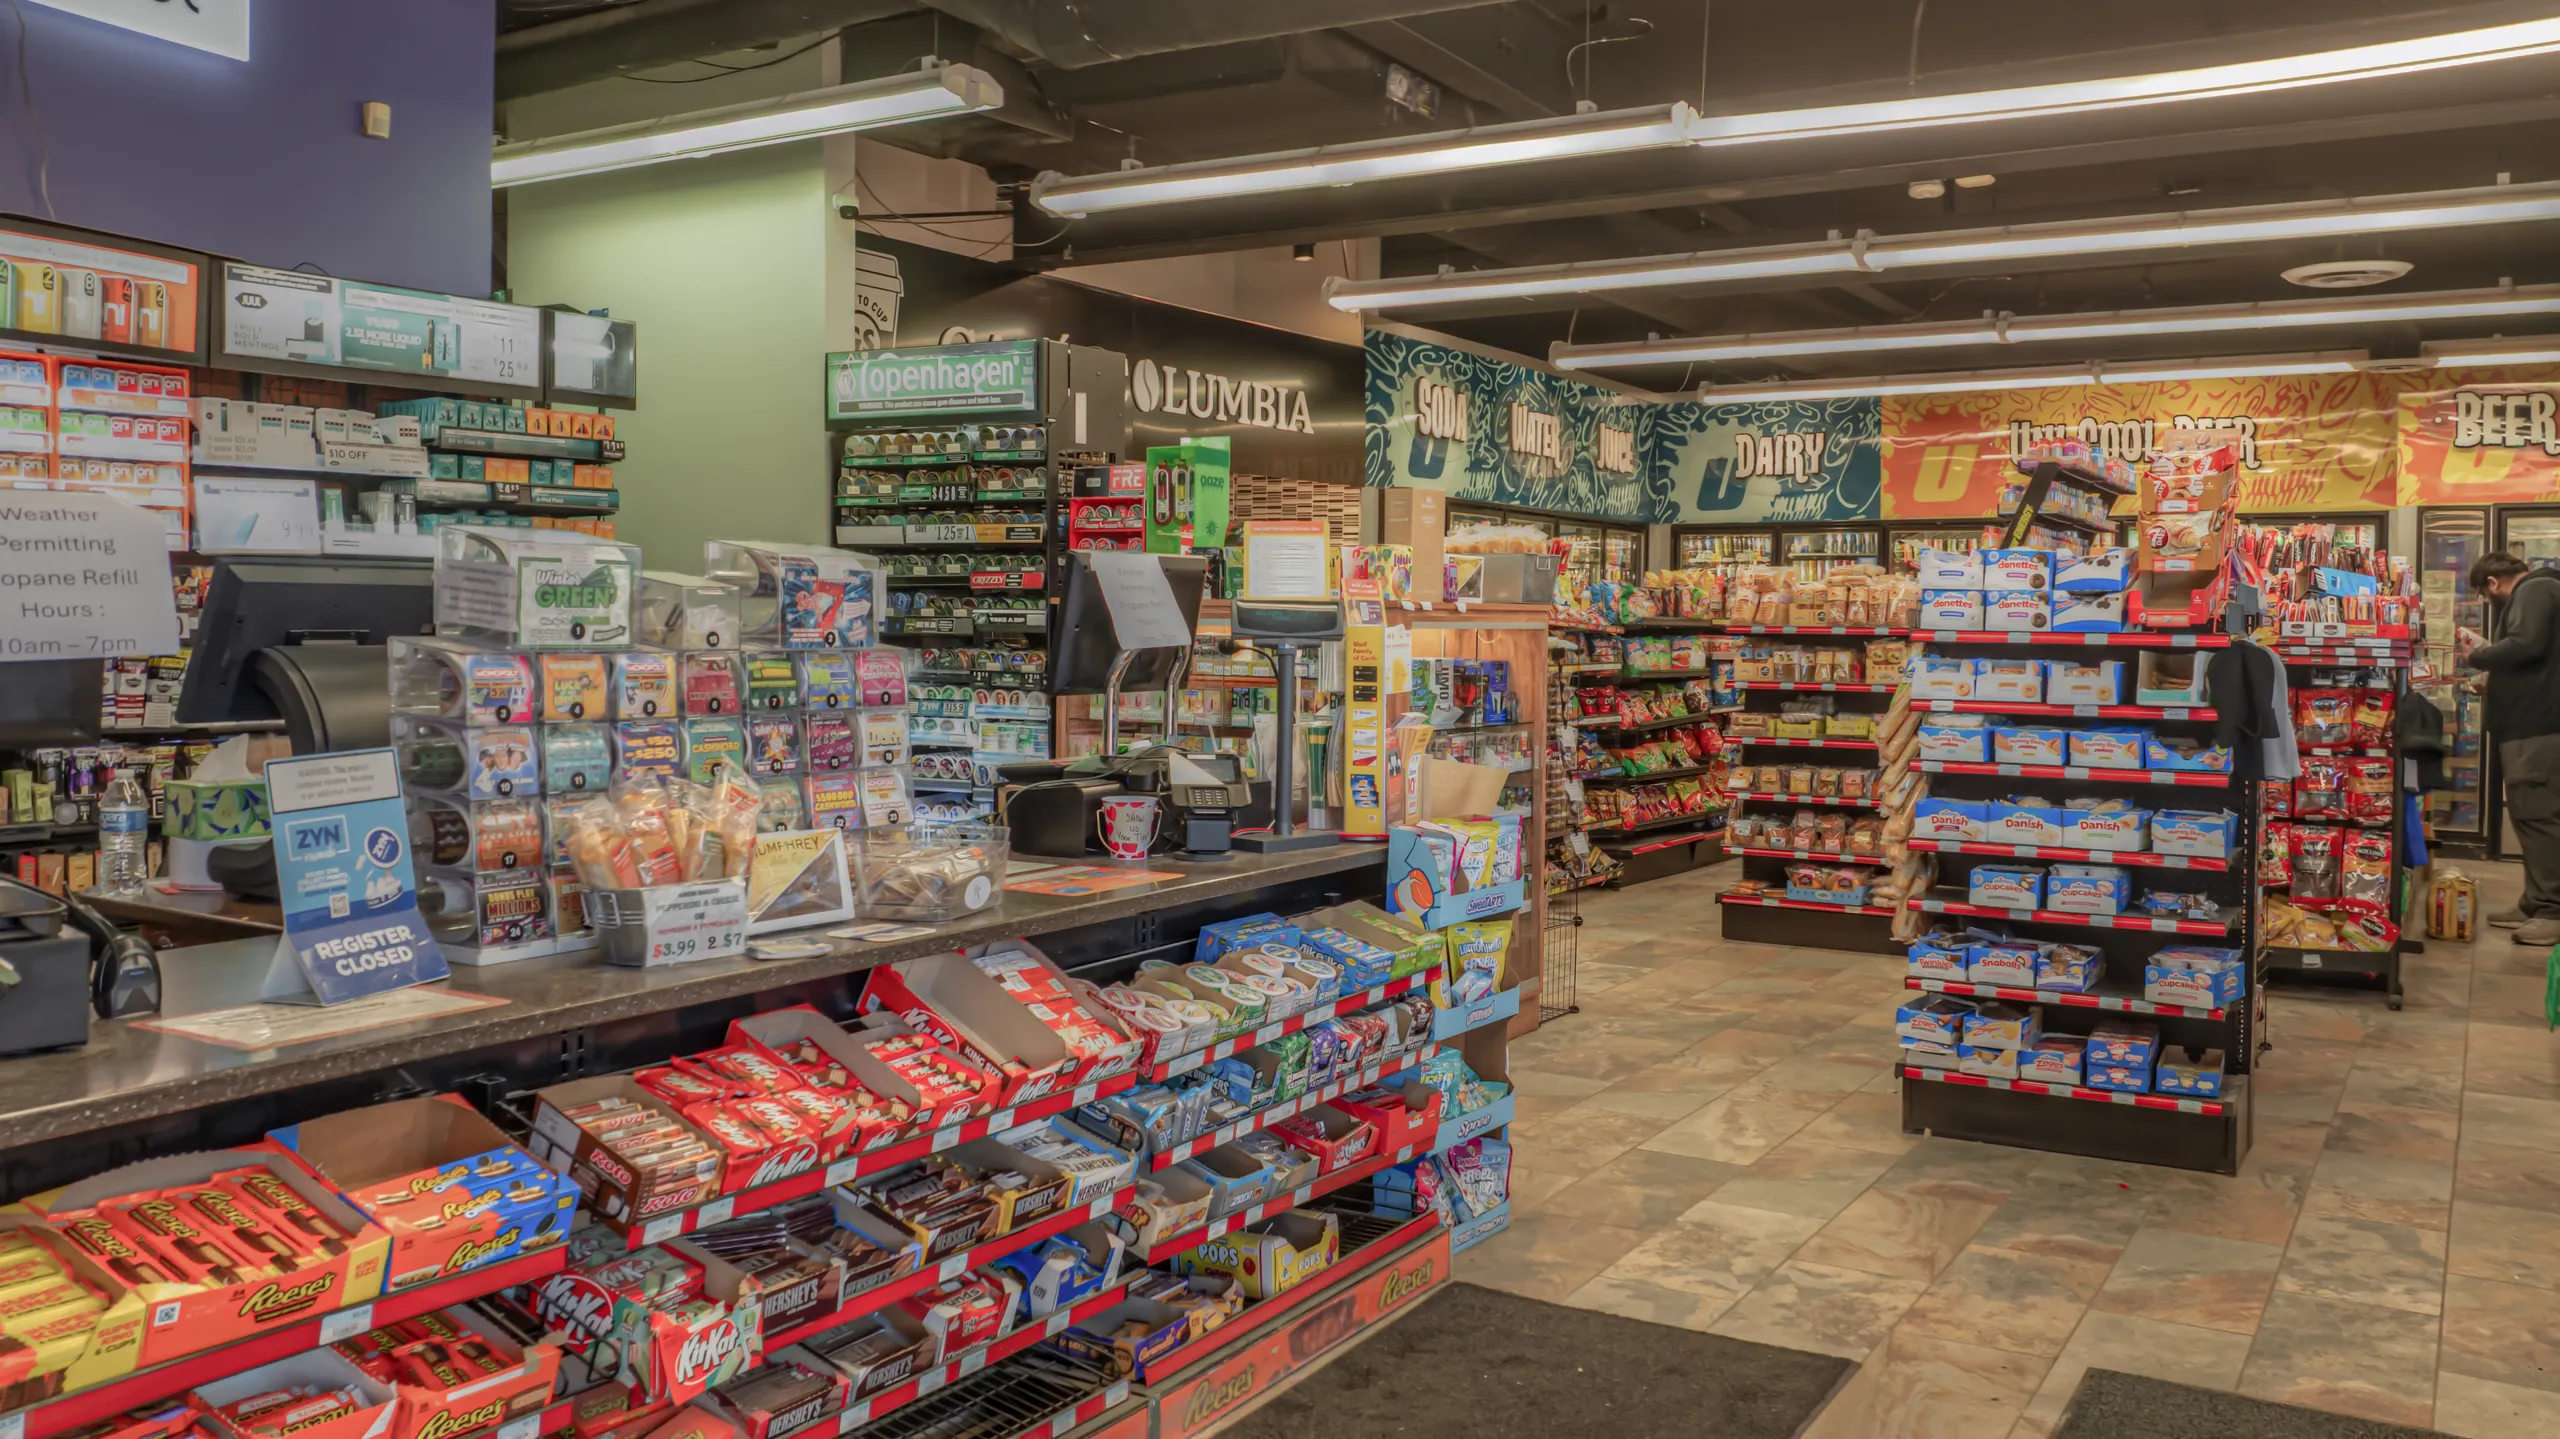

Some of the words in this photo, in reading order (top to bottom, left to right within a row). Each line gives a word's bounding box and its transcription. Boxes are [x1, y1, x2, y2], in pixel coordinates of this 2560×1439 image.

[857, 294, 869, 306] TO
[871, 302, 888, 323] CUP
[1416, 375, 1468, 443] SODA
[1510, 400, 1562, 471] WATER
[2453, 390, 2560, 456] BEER
[328, 449, 346, 459] $10
[348, 451, 368, 460] OFF
[1596, 421, 1638, 474] JUICE
[1734, 432, 1827, 485] DAIRY
[1112, 469, 1143, 488] FRE
[0, 507, 99, 522] Weather
[83, 569, 139, 585] Refill
[535, 570, 581, 586] Winter
[1997, 560, 2040, 571] donettes
[972, 575, 1005, 585] GRIZZLY
[21, 602, 93, 619] Hours
[534, 586, 614, 609] GREEN
[1932, 598, 1974, 609] donettes
[1998, 599, 2041, 610] donettes
[87, 635, 137, 653] 7pm
[1352, 648, 1373, 656] Family
[1931, 815, 1969, 827] Danish
[2005, 818, 2044, 831] Danish
[2080, 820, 2121, 832] Danish
[295, 824, 341, 850] ZYN
[1983, 882, 2024, 894] Cupcakes
[2061, 887, 2102, 900] Cupcakes
[486, 899, 541, 918] MILLIONS
[314, 925, 413, 961] REGISTER
[652, 939, 696, 960] $3.99
[335, 945, 414, 977] CLOSED
[1918, 958, 1954, 970] Twinkies
[2157, 979, 2199, 992] Cupcakes
[963, 1046, 985, 1065] KING
[1457, 1114, 1492, 1138] Spree
[590, 1148, 632, 1185] Rolo
[247, 1174, 309, 1212] Reese's
[411, 1165, 471, 1195] Reese's
[1076, 1177, 1116, 1201] HERSHEY'S
[196, 1188, 259, 1230] Reese's
[443, 1189, 502, 1220] Reese's
[641, 1187, 698, 1213] Rolo
[1015, 1187, 1056, 1217] HERSHEY'S
[139, 1200, 200, 1240] Reese's
[75, 1218, 137, 1259] Reese's
[446, 1227, 522, 1271] Reese's
[935, 1221, 979, 1251] HERSHEY'S
[1198, 1243, 1239, 1267] POPS
[1298, 1252, 1321, 1272] POPS
[239, 1271, 337, 1317] Reese's
[763, 1278, 819, 1318] HERSHEY'S
[1379, 1258, 1434, 1313] Reese's
[676, 1318, 740, 1385] KitKat
[866, 1355, 914, 1389] HERSHEY'S
[1182, 1363, 1256, 1432] Reese's
[417, 1398, 507, 1439] Reese's
[767, 1399, 823, 1439] HERSHEY'S
